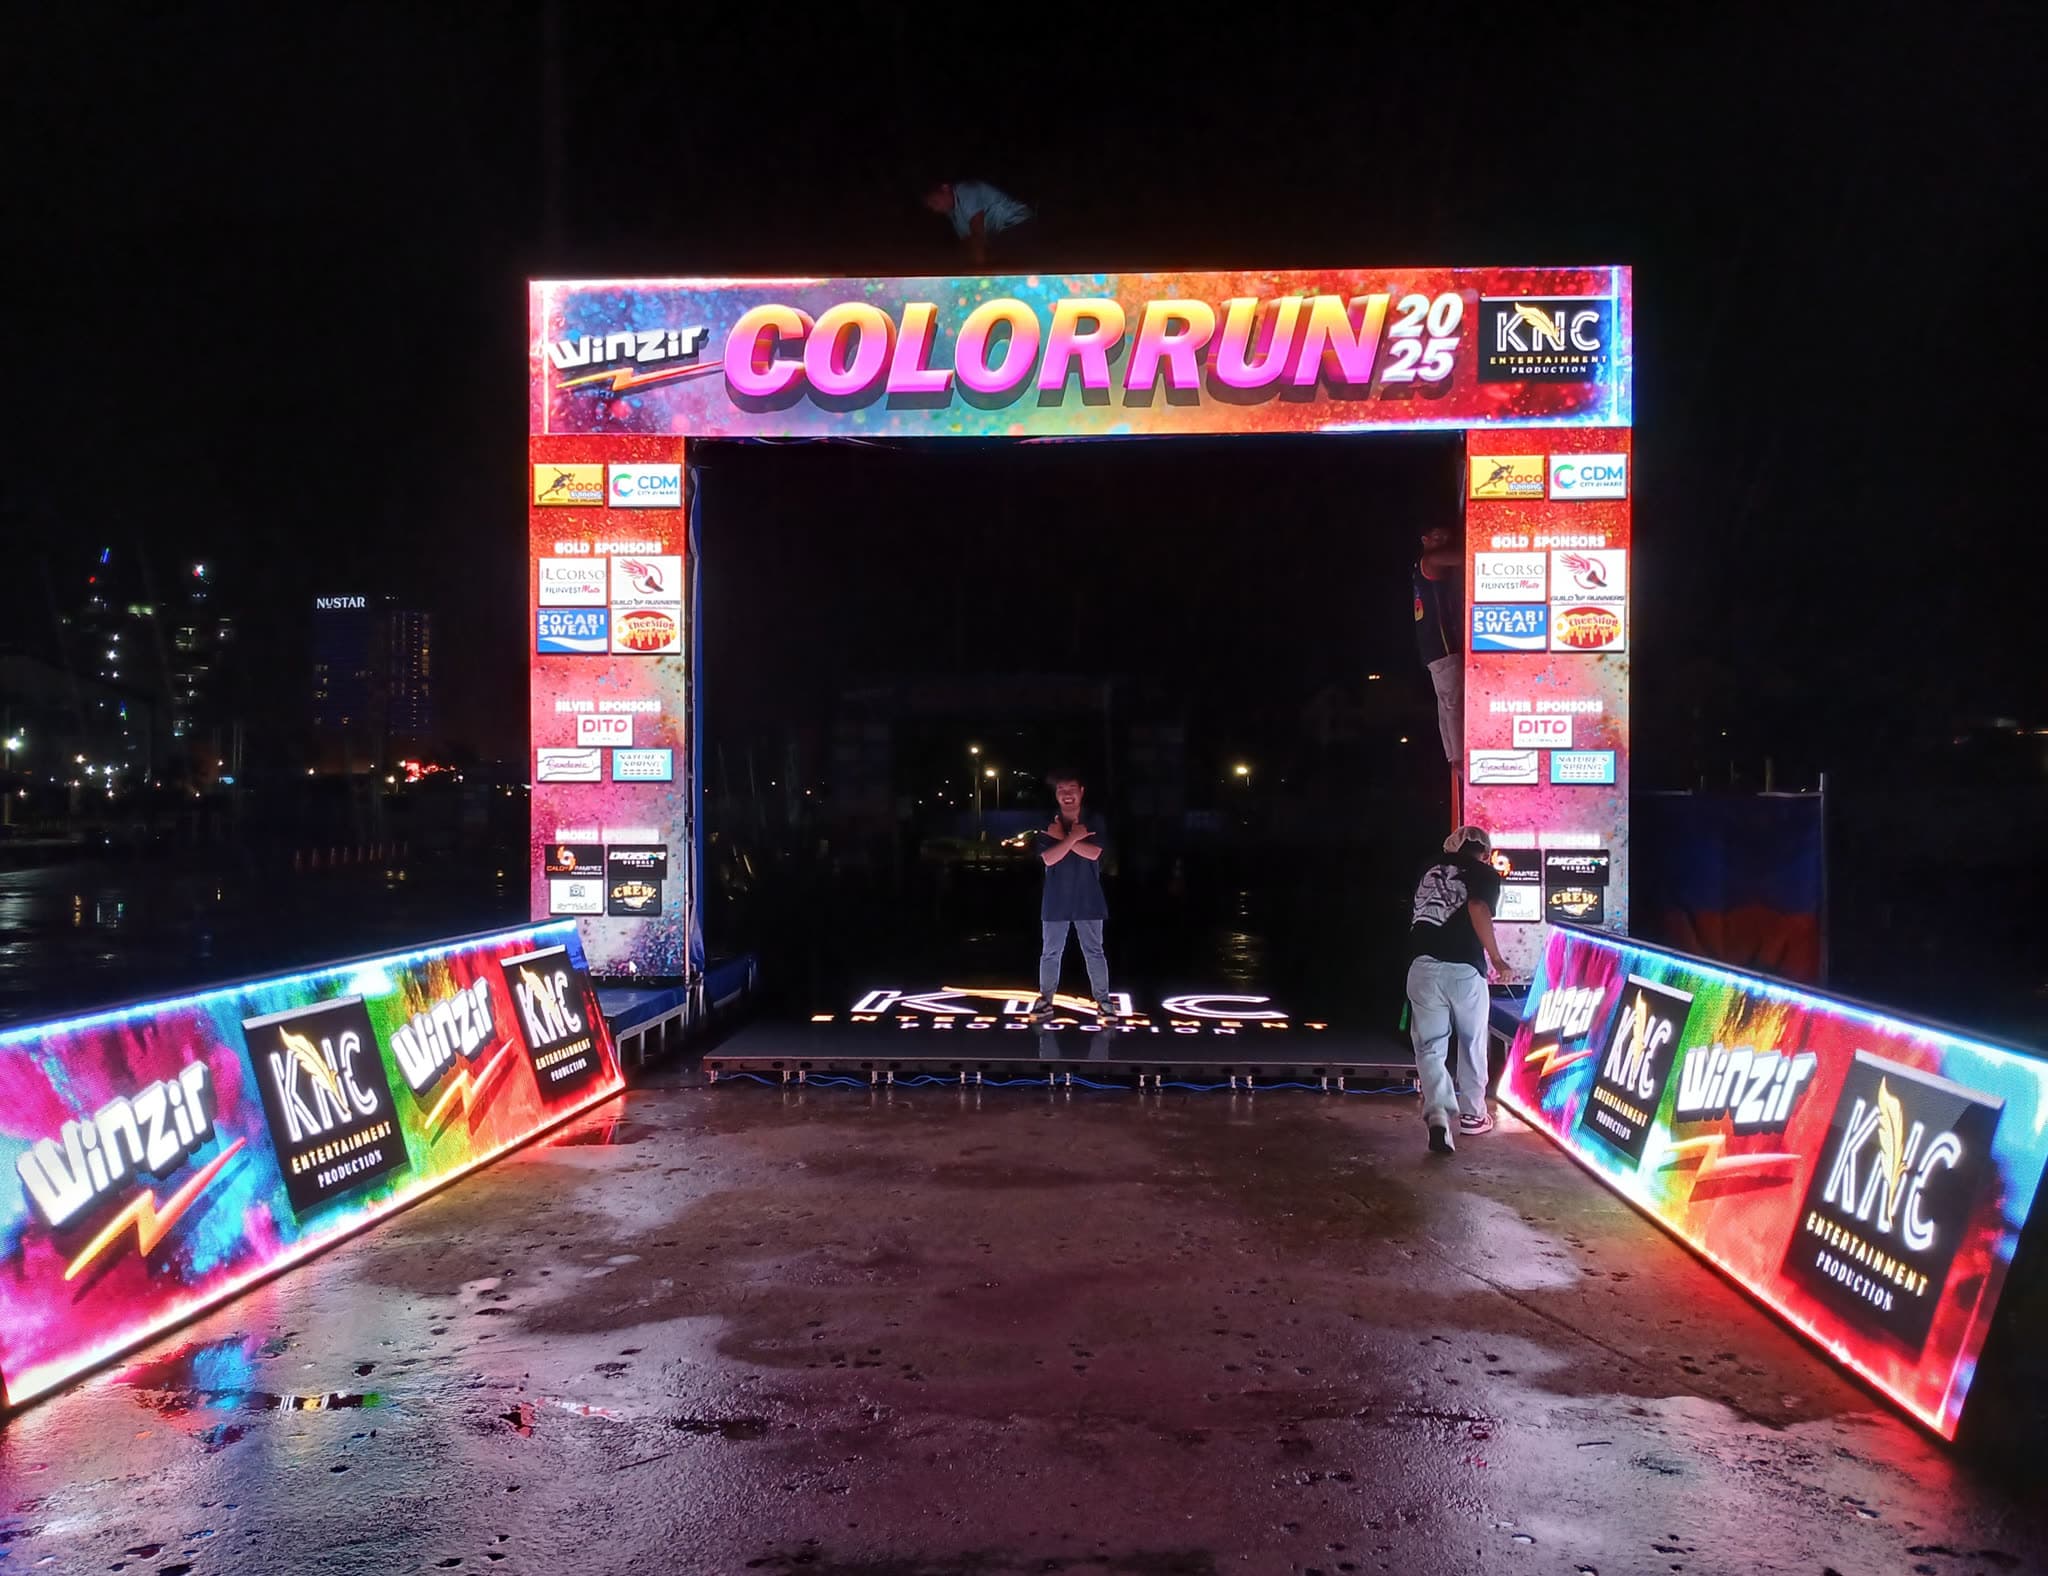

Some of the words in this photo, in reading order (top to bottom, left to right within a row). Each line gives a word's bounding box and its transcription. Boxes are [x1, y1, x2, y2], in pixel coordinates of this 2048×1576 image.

[1387, 292, 1463, 339] 20
[1496, 310, 1601, 353] KNC
[1380, 335, 1460, 383] 25
[1489, 355, 1608, 365] ENTERTAINMENT
[1511, 366, 1587, 374] PRODUCTION
[1505, 474, 1543, 484] COCO
[1580, 466, 1623, 481] CDM
[566, 482, 602, 492] COCO
[637, 475, 678, 489] CDM
[555, 542, 590, 554] GOLD
[594, 541, 662, 554] SPONSORS
[1491, 536, 1529, 548] GOLD
[1533, 535, 1606, 547] SPONSORS
[539, 614, 605, 625] POCARI
[1474, 611, 1543, 622] POCARI
[539, 624, 599, 635] SWEAT
[1474, 621, 1537, 632] SWEAT
[583, 719, 627, 733] DITO
[1518, 720, 1566, 734] DITO
[612, 884, 657, 898] CREW
[1551, 891, 1598, 905] CREW
[515, 970, 582, 1048] KNC
[899, 1022, 1237, 1036] PRODUCTION
[535, 1038, 592, 1071] ENTERTAINMENT
[1603, 1005, 1673, 1100] KNC
[550, 1057, 588, 1082] PRODUCTION
[269, 1029, 378, 1143] KNC
[1593, 1085, 1649, 1128] ENTERTAINMENT
[291, 1120, 392, 1175] ENTERTAINMENT
[317, 1149, 383, 1188] PRODUCTION
[1823, 1095, 1963, 1252] KNC
[1806, 1210, 1929, 1297] ENTERTAINMENT
[1816, 1249, 1894, 1312] PRODUCTION
